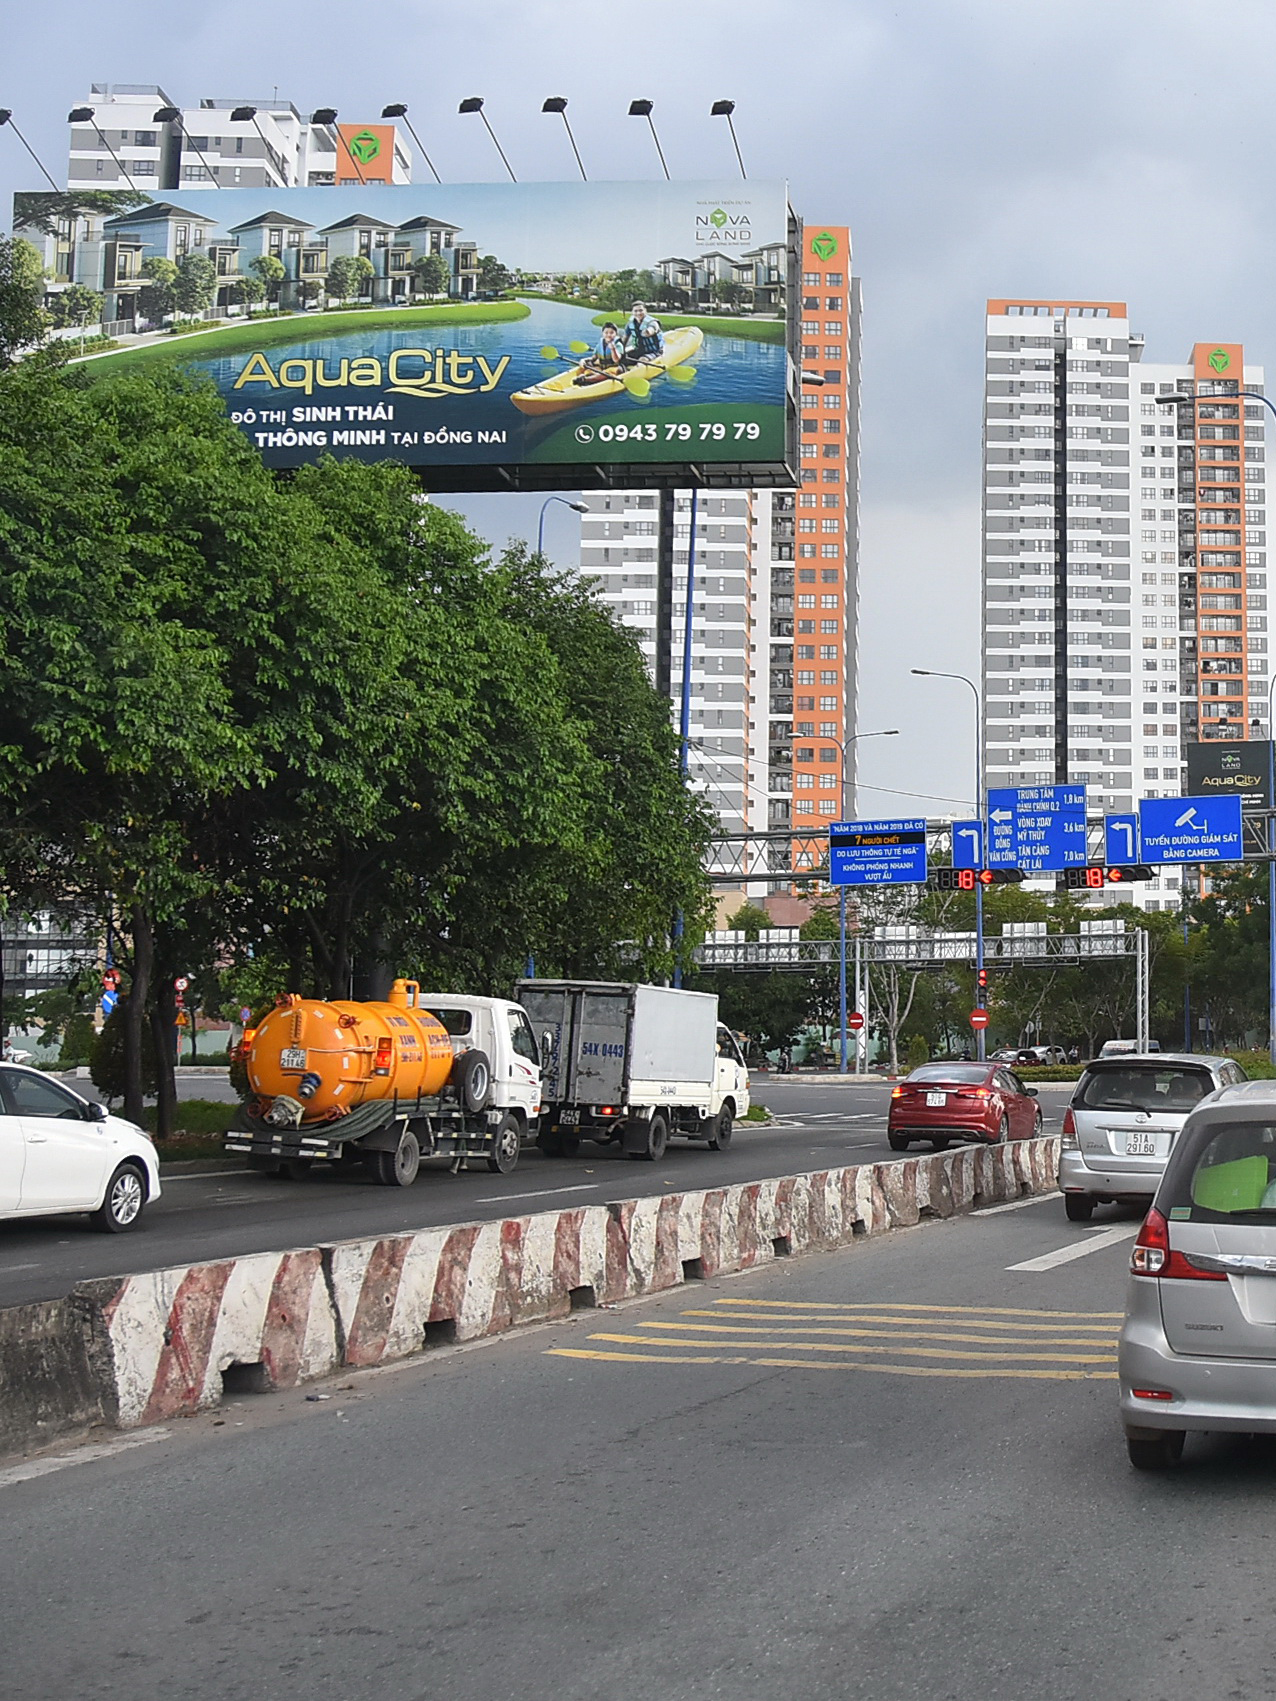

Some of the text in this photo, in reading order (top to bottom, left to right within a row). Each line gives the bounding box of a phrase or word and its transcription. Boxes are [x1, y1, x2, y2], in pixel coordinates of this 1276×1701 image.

[696, 231, 751, 240] LAND
[231, 402, 393, 425] ĐÔ THỊ SINH THÁI
[255, 426, 506, 448] THÔNG MINH TẠI ĐỒNG NAI
[599, 423, 760, 441] 0943 79 79 79
[1017, 789, 1054, 800] TRUNG TÂM
[1076, 794, 1084, 803] km
[864, 823, 873, 831] VÀ
[915, 821, 923, 829] CÓ
[1017, 817, 1035, 828] VÒNG
[1075, 822, 1084, 832] km
[855, 835, 900, 845] 7 NGƯỜI CHẾT
[1145, 832, 1238, 846] TUYẾN ĐƯỜNG GIÁM SÁT
[862, 848, 882, 856] THÔNG
[1018, 846, 1032, 856] TÂN
[1075, 851, 1084, 860] km
[1164, 847, 1219, 858] BẰNG CAMERA
[843, 863, 865, 871] KHÔNG
[866, 862, 888, 870] PHÓNG
[1018, 858, 1042, 869] CÁT LÁI
[865, 873, 881, 881] VƯỢT
[959, 869, 974, 889] 18
[1086, 868, 1103, 887] 18
[582, 1042, 624, 1058] 54X 0443
[1133, 1134, 1148, 1143] 51A
